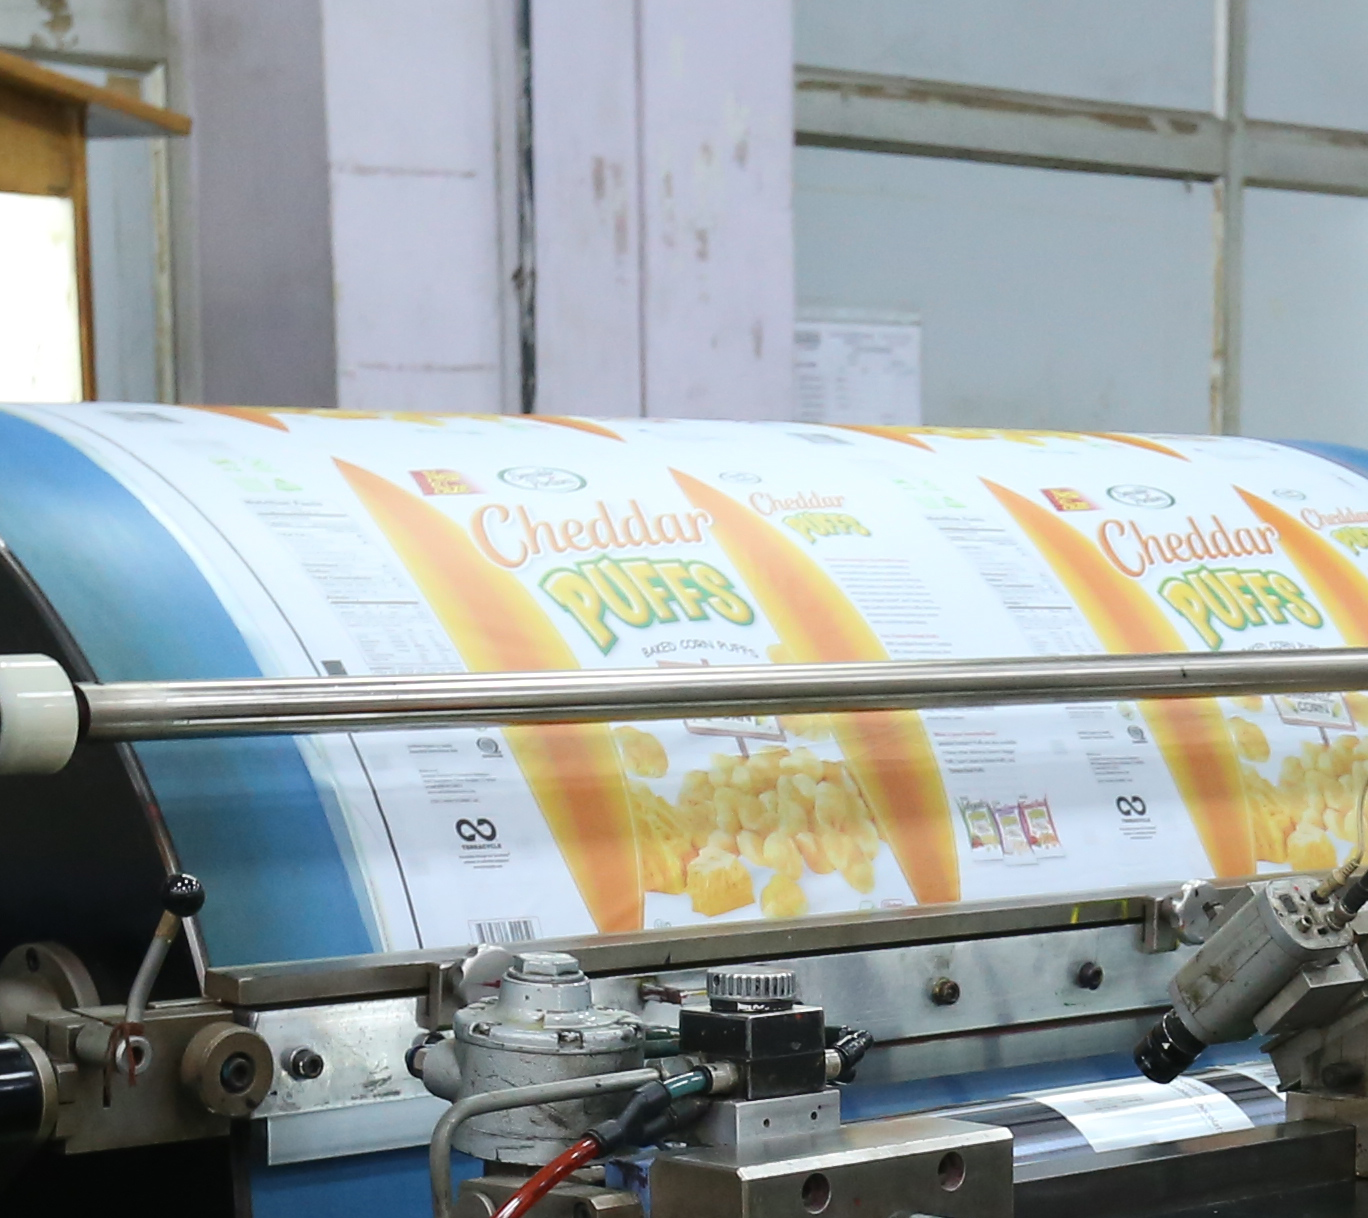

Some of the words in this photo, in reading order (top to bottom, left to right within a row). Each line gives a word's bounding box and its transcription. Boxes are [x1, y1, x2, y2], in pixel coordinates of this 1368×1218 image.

[470, 499, 710, 569] Cheddar
[749, 491, 845, 516] Cheddar
[1097, 514, 1278, 578] Cheddar
[538, 555, 754, 657] PUFFS
[1158, 565, 1324, 651] PUFFS
[641, 641, 677, 658] BAKED
[680, 639, 714, 651] CORN
